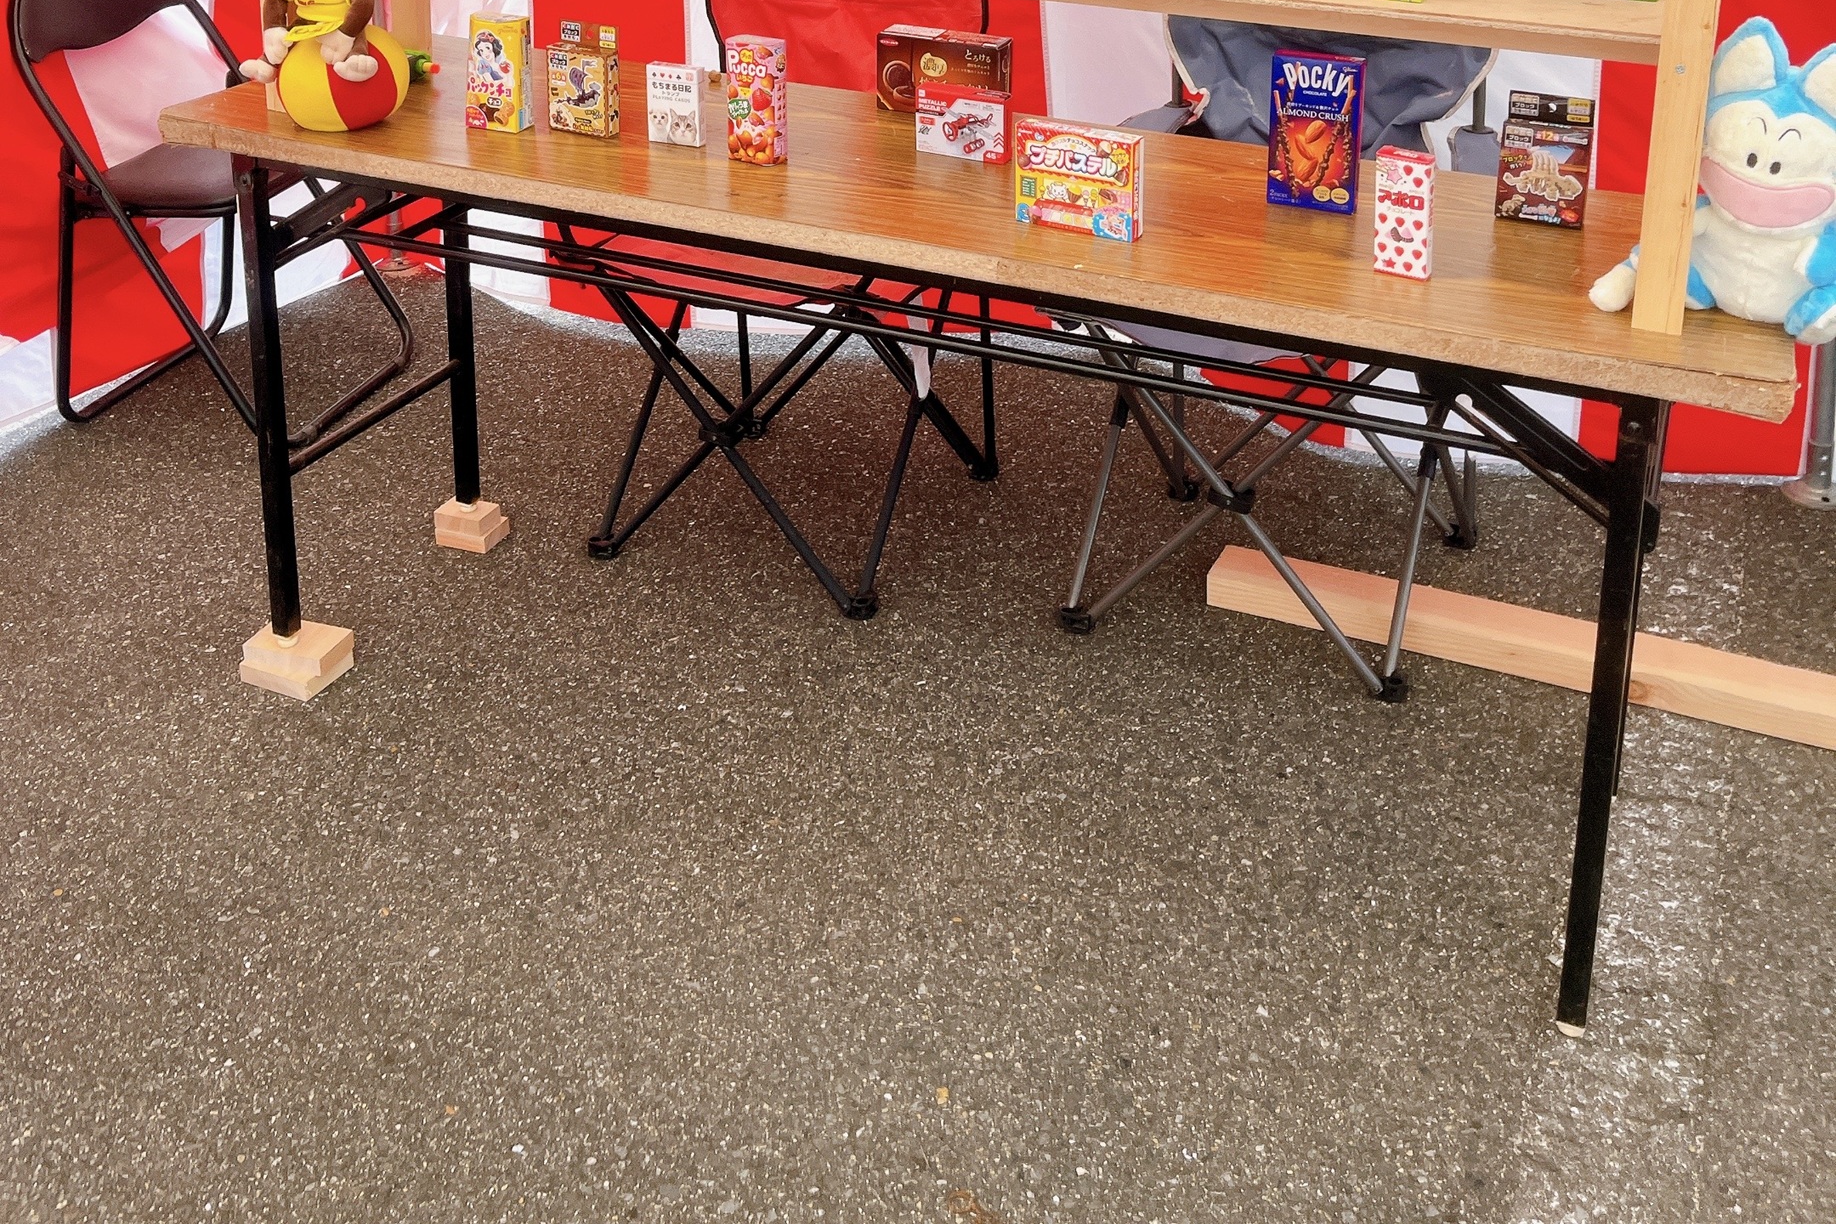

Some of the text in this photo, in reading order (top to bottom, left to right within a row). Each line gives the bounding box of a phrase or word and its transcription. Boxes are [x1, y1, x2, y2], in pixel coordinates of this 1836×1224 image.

[727, 49, 767, 78] Pucca
[964, 48, 992, 63] とろける
[467, 76, 512, 97] パックンチョ
[652, 81, 692, 93] もちまる日記
[1283, 62, 1351, 97] Pocky
[918, 97, 947, 107] METALLIC
[918, 103, 941, 112] PUZZLE
[1277, 107, 1349, 123] ALMOND CRUSH
[1029, 144, 1118, 178] プチパステル
[1377, 188, 1425, 211] アポロ
